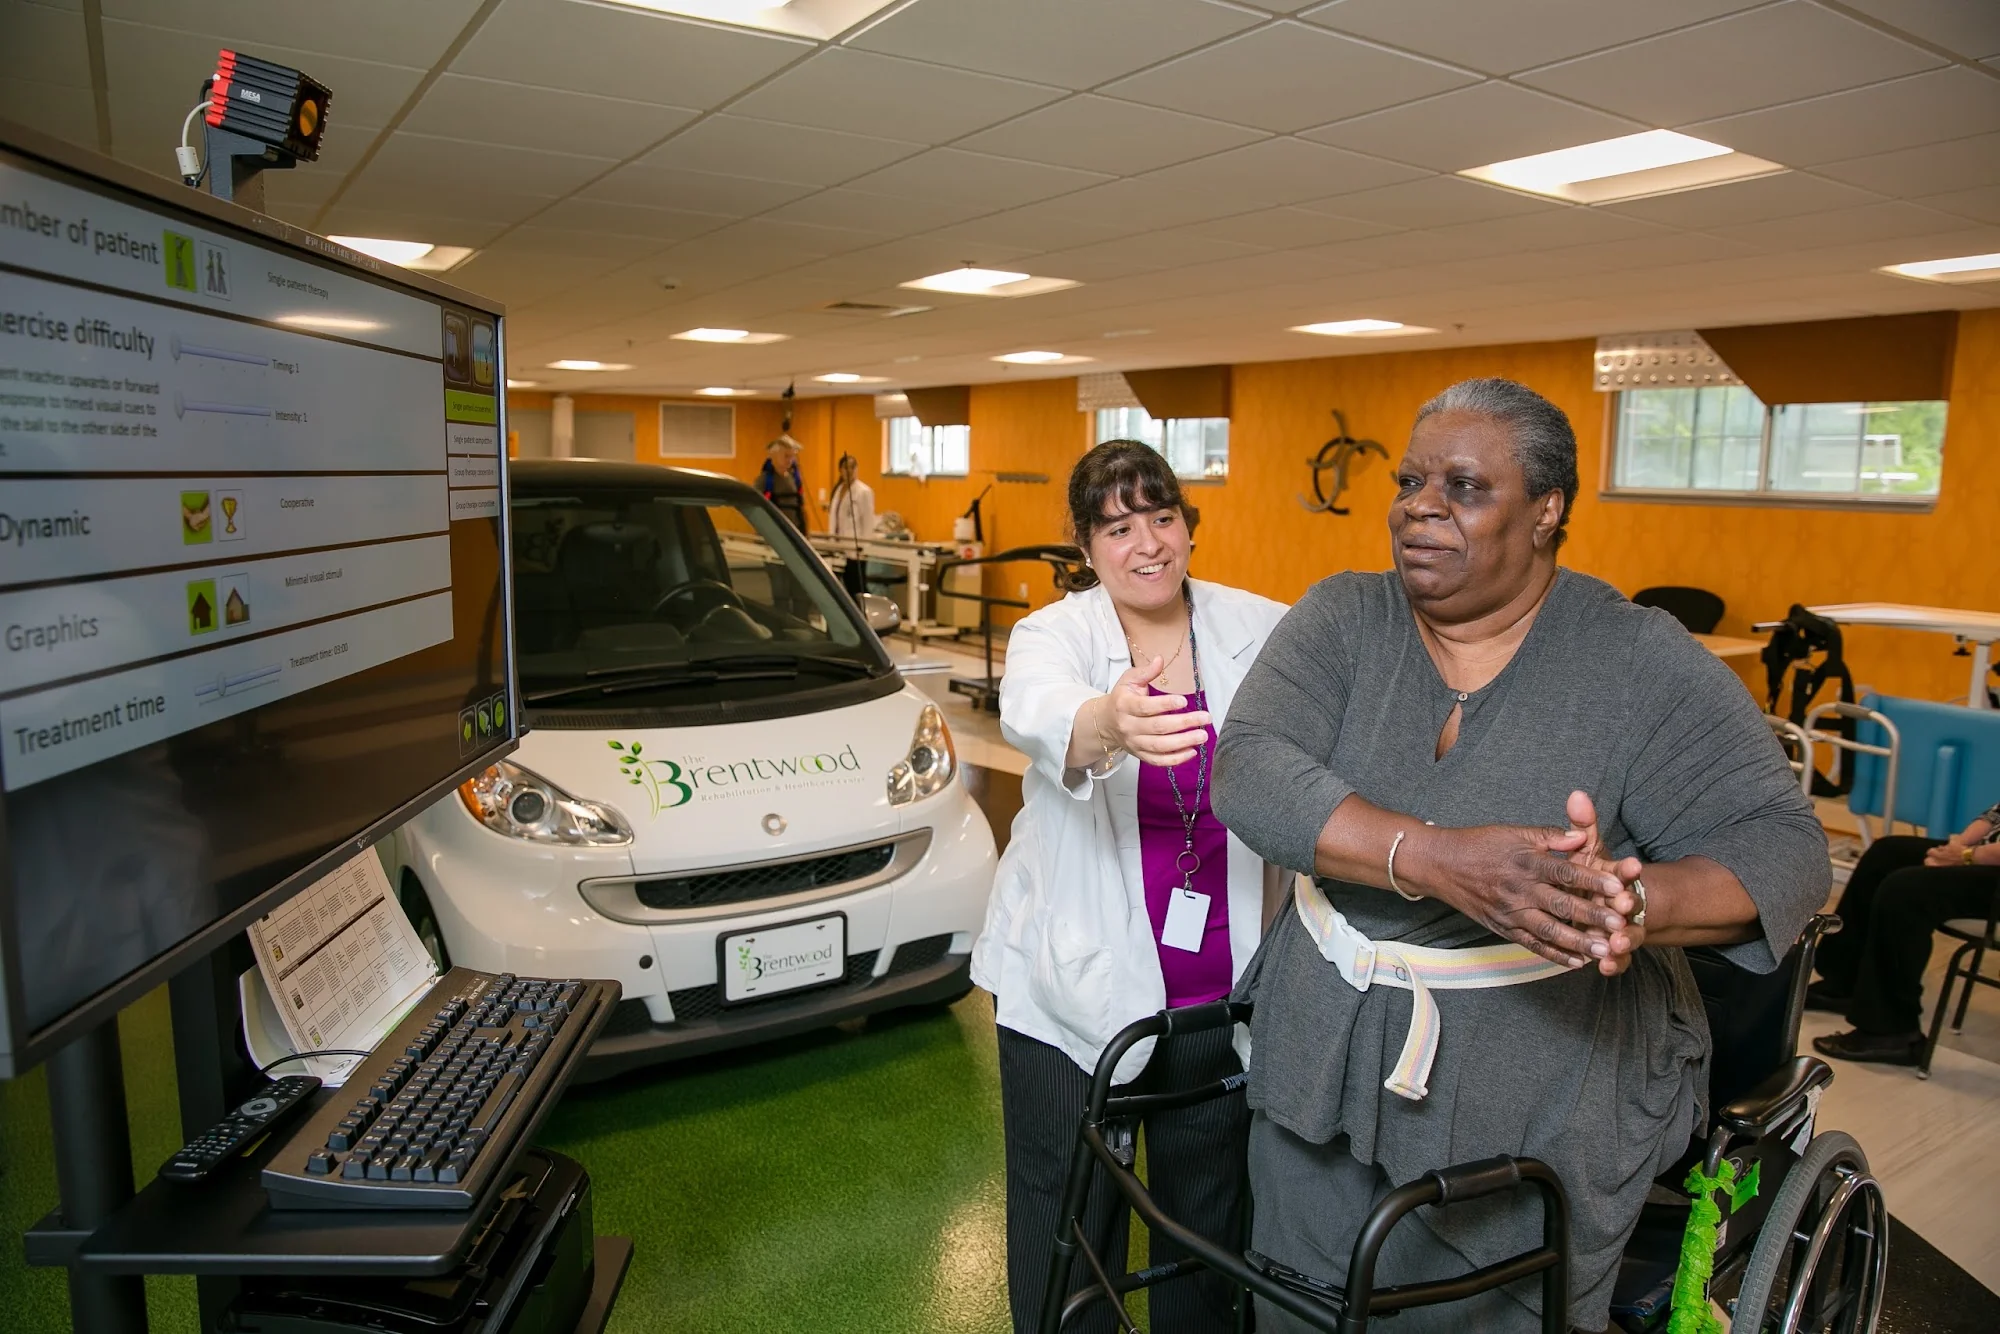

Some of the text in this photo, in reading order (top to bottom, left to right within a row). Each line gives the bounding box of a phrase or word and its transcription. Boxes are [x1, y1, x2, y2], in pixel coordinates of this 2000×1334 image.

[241, 89, 260, 100] MESA
[68, 219, 88, 246] of
[95, 230, 160, 264] patient
[267, 271, 328, 300] Single patient therapy
[75, 316, 154, 360] difficulty
[272, 358, 294, 374] Timing:
[112, 380, 122, 391] or
[125, 377, 160, 394] forward
[125, 403, 144, 414] cues
[146, 403, 156, 415] to
[275, 409, 302, 424] Intensity:
[61, 419, 79, 433] the
[82, 420, 109, 434] other
[110, 422, 129, 435] side
[131, 423, 140, 436] of
[142, 423, 157, 437] the
[280, 497, 314, 510] Cooperative
[0, 509, 90, 546] Dynamic
[285, 568, 343, 587] Minimal visual stimuli
[5, 613, 98, 652] Graphics
[290, 652, 318, 668] Treatment
[320, 649, 333, 660] time:
[15, 694, 165, 755] Treatment time
[682, 754, 706, 766] The
[648, 744, 861, 808] Brentwood
[701, 786, 771, 802] Rehabilitation
[785, 778, 834, 792] Healthcare
[751, 944, 832, 980] Brentwood
